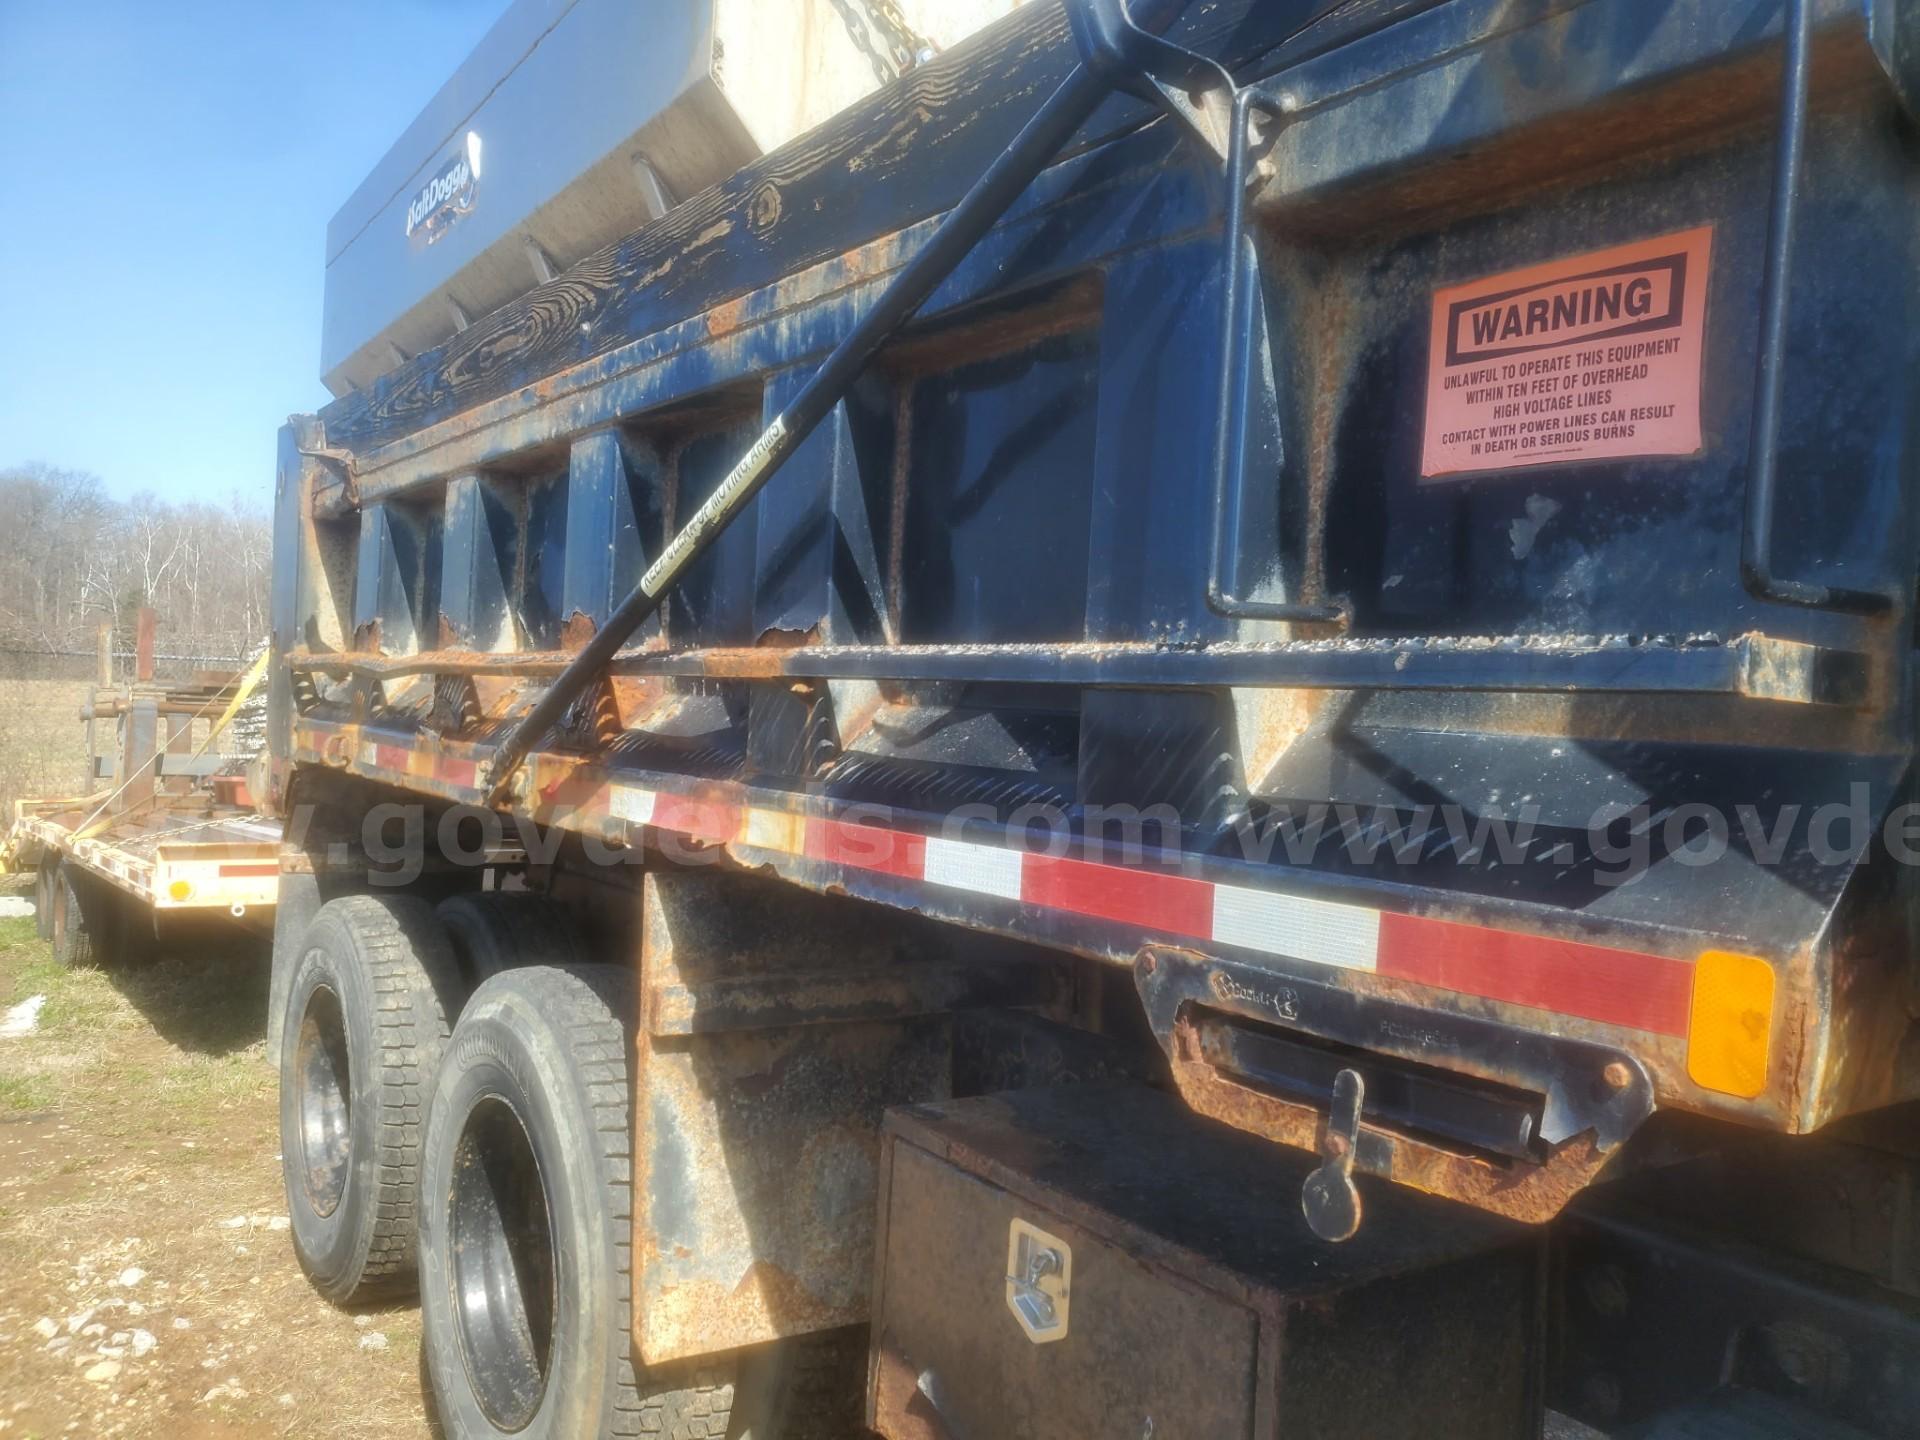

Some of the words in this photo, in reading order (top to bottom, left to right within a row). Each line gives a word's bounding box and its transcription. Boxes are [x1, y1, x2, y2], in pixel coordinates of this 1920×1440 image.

[1472, 277, 1652, 346] WARNING
[1444, 368, 1498, 390] UNLAWFUL
[1502, 364, 1516, 380] TO
[1520, 355, 1572, 377] OPERATE
[1576, 349, 1604, 368] THIS
[1608, 337, 1680, 363] EQUIPMENT
[1466, 386, 1504, 405] WITHIN
[1507, 382, 1528, 398] TEN
[1532, 377, 1559, 395] FEET
[1563, 374, 1578, 390] OF
[1582, 364, 1648, 387] OVERHEAD
[1493, 403, 1520, 419] HIGH
[1524, 395, 1573, 415] VOLTAGE
[1577, 389, 1612, 408] LINES
[1442, 428, 1486, 445] CONTACT
[1489, 424, 1516, 438] WITH
[1520, 418, 1560, 434] POWER
[1564, 413, 1597, 428] LINES
[1601, 409, 1625, 424] CAN
[1630, 404, 1676, 421] RESULT
[1471, 443, 1481, 455] IN
[1485, 439, 1518, 453] DEATH
[1521, 436, 1536, 449] OR
[1540, 429, 1590, 446] SERIOUS
[1594, 425, 1635, 440] BURNS
